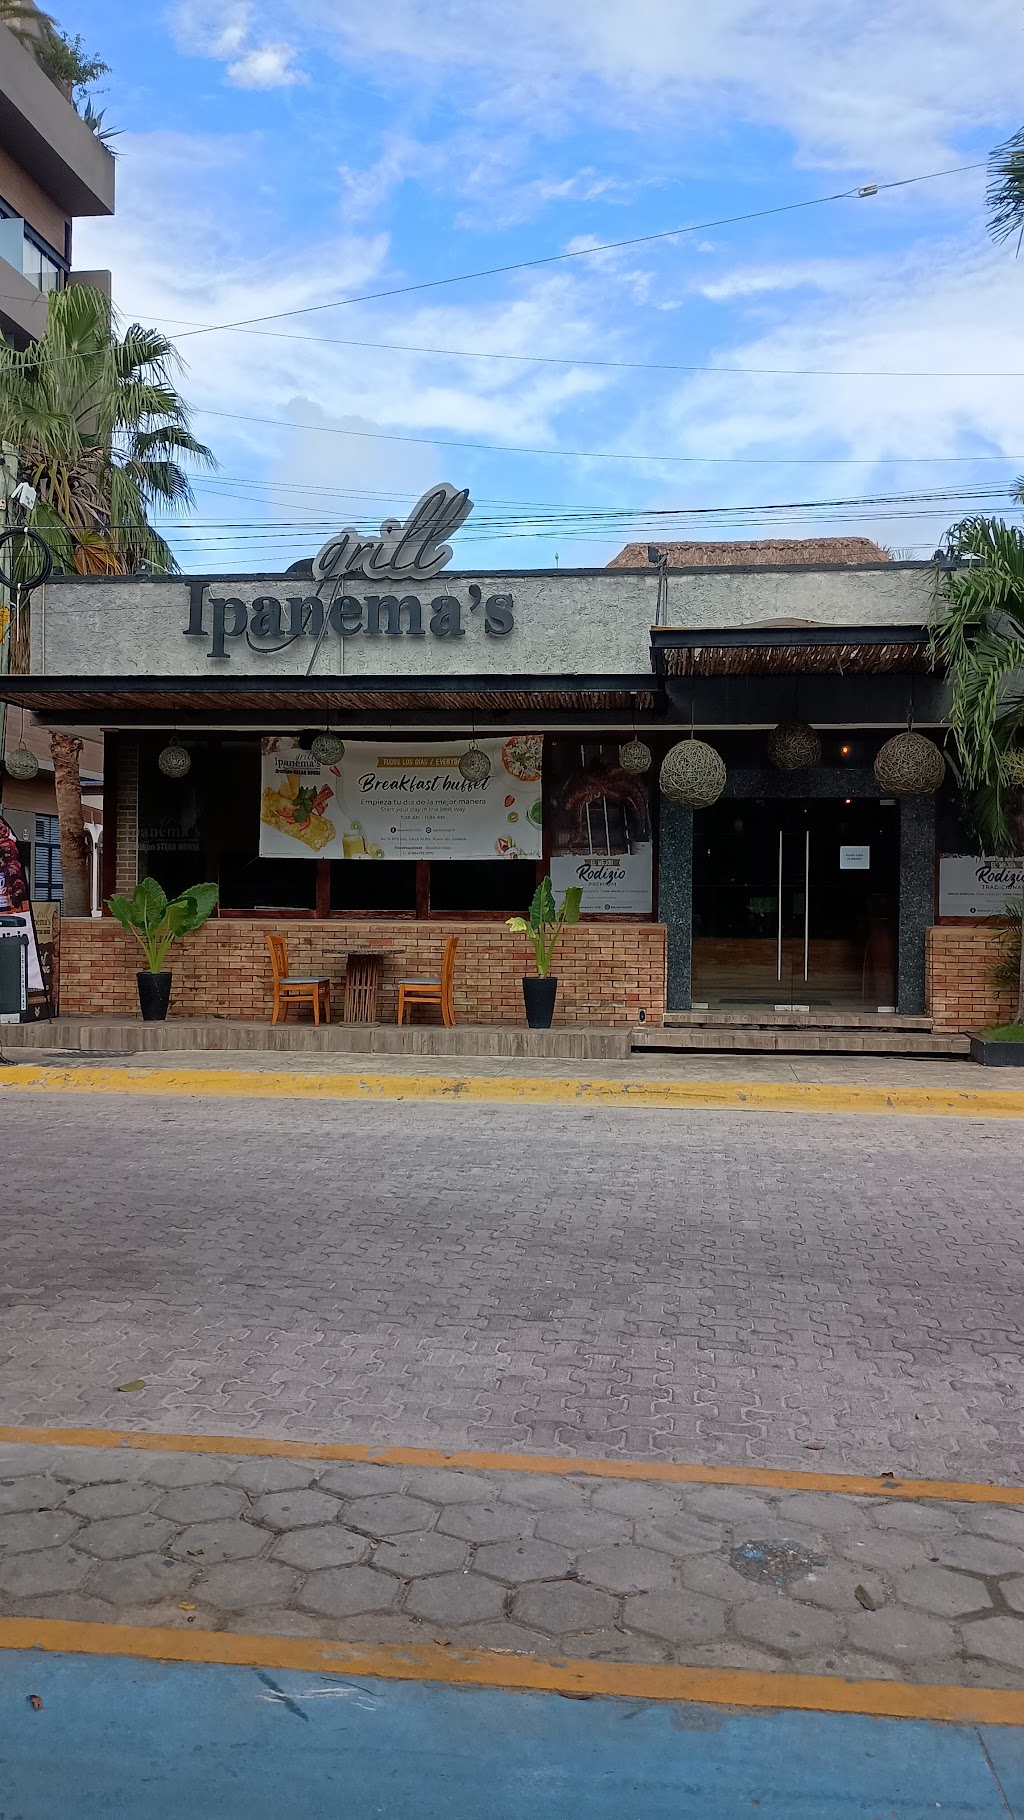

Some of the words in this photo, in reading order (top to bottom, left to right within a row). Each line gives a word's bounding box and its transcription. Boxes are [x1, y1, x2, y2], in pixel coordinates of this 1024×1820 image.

[314, 488, 470, 597] grill
[183, 581, 515, 658] Ipanema's
[274, 757, 321, 768] Ipanema's
[358, 773, 443, 793] Breakfast
[443, 774, 495, 793] buffet
[360, 798, 392, 807] Empieza
[393, 798, 402, 806] tu
[415, 798, 426, 806] de
[427, 798, 434, 806] la
[435, 799, 457, 808] mejor
[458, 798, 487, 806] manera
[409, 806, 420, 814] day
[156, 842, 177, 851] STEAK
[575, 864, 626, 886] Rodizio
